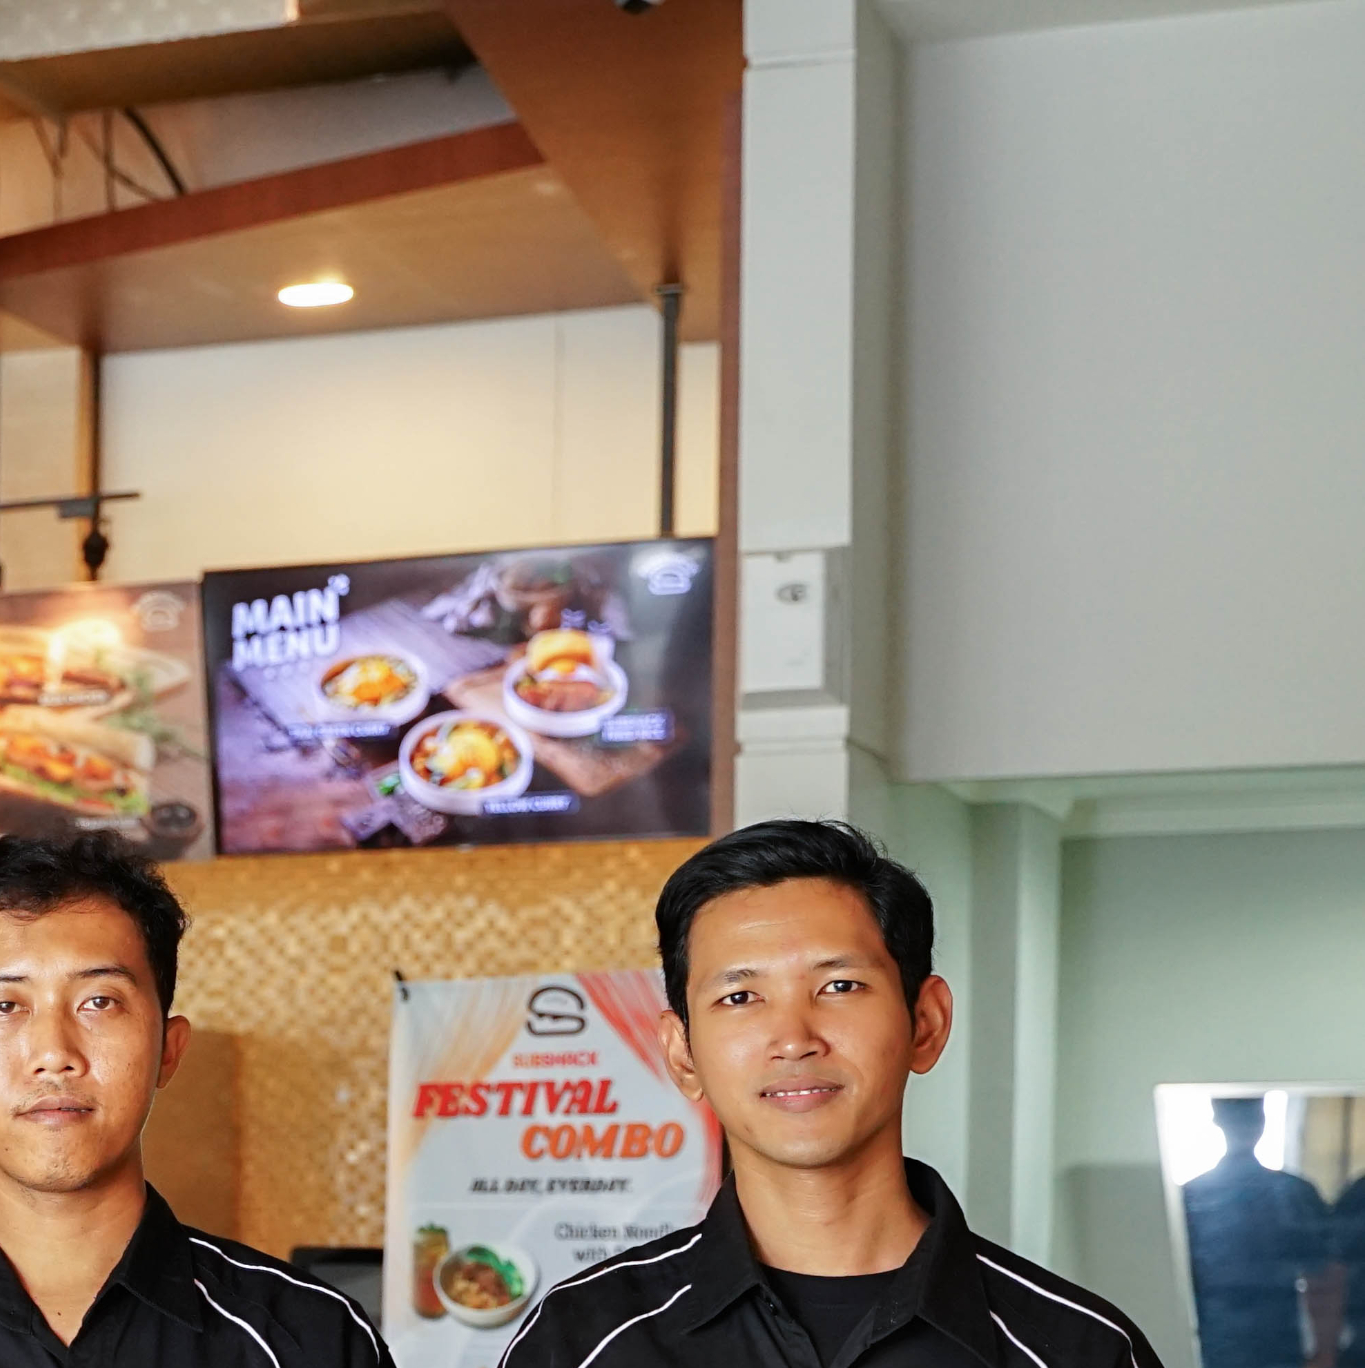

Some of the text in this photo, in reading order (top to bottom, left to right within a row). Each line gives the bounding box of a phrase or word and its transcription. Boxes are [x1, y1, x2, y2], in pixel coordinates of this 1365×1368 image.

[232, 586, 340, 639] MAIN
[232, 623, 340, 671] MENU
[413, 1079, 619, 1118] FESTIVAL
[521, 1122, 686, 1161] COMBO
